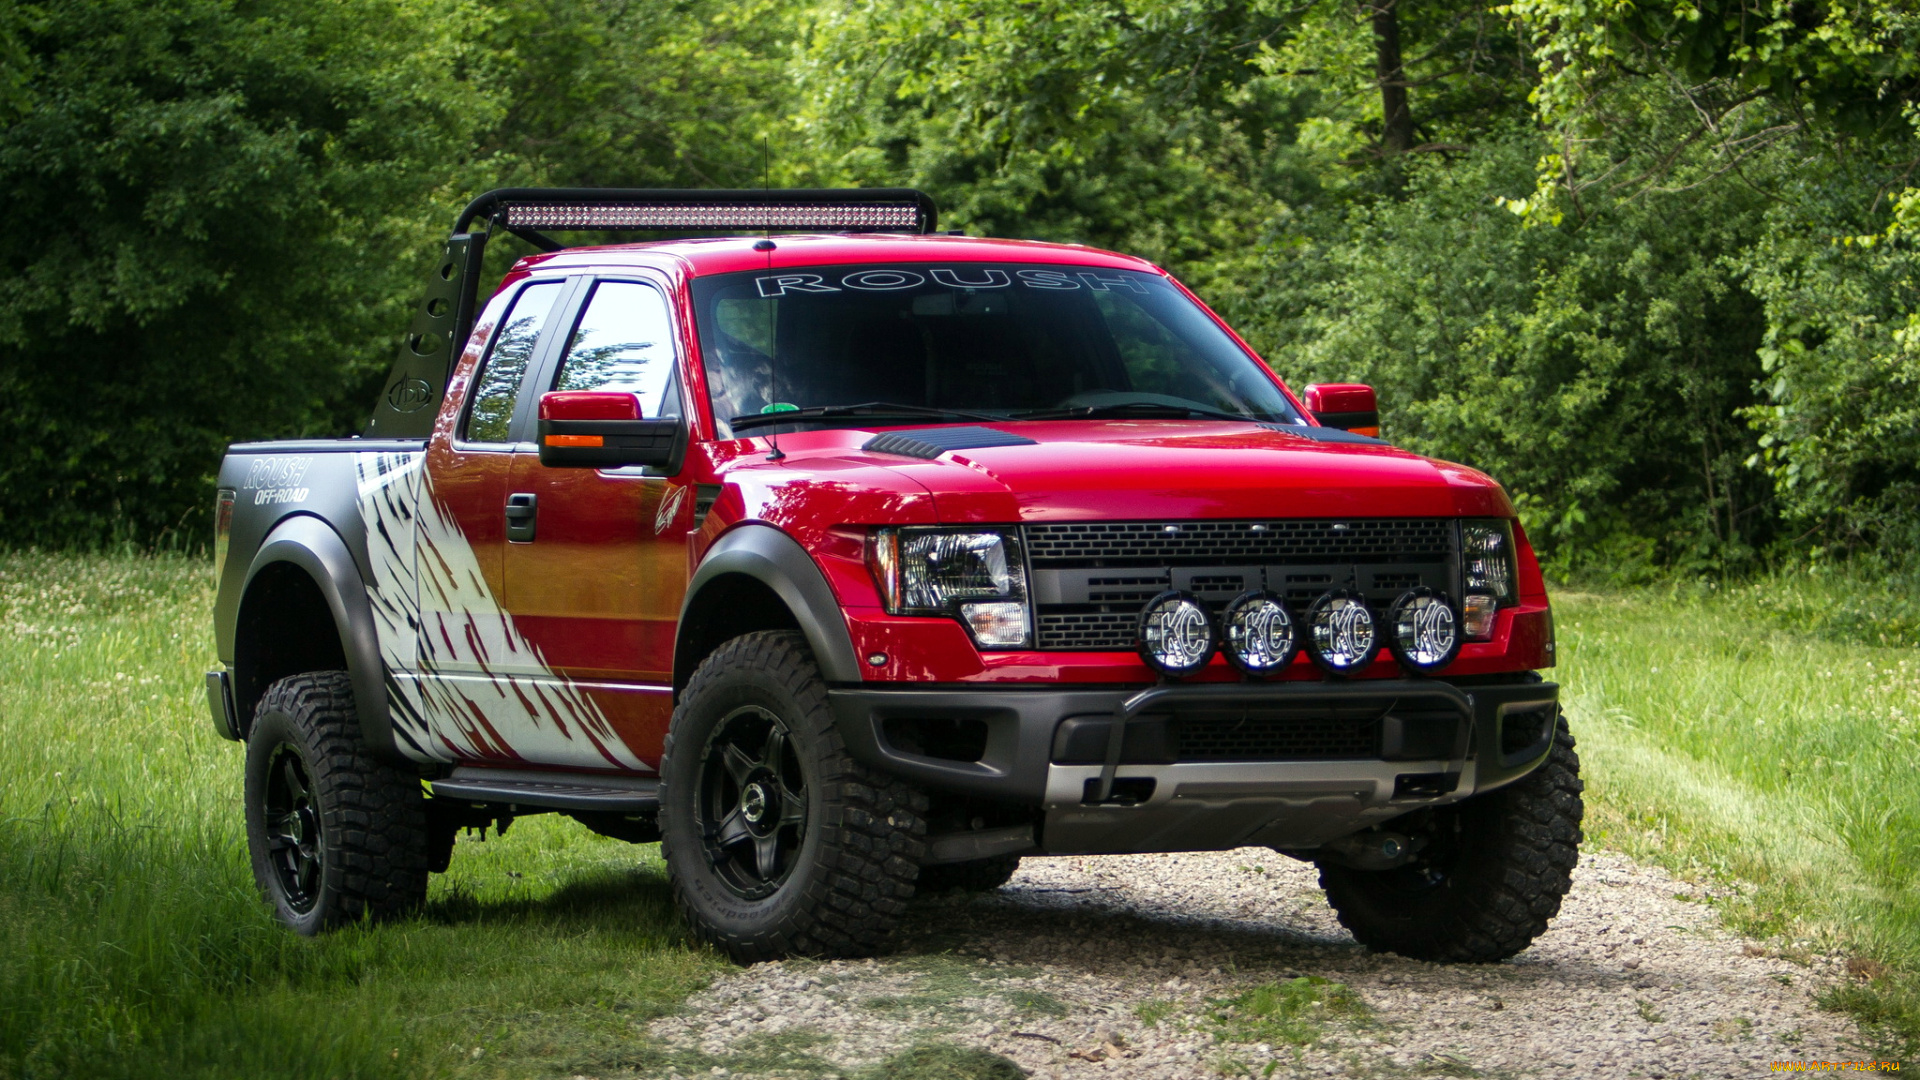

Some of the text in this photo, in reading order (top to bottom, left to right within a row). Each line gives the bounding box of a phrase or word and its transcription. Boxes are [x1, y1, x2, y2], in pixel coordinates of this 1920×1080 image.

[755, 268, 1151, 298] ROUSH
[243, 456, 314, 490] ROUSH
[254, 487, 310, 505] OFF-ROAD
[1161, 602, 1205, 661] KC
[1245, 602, 1287, 660] KC
[1329, 602, 1371, 659] KC
[1413, 601, 1454, 657] KC
